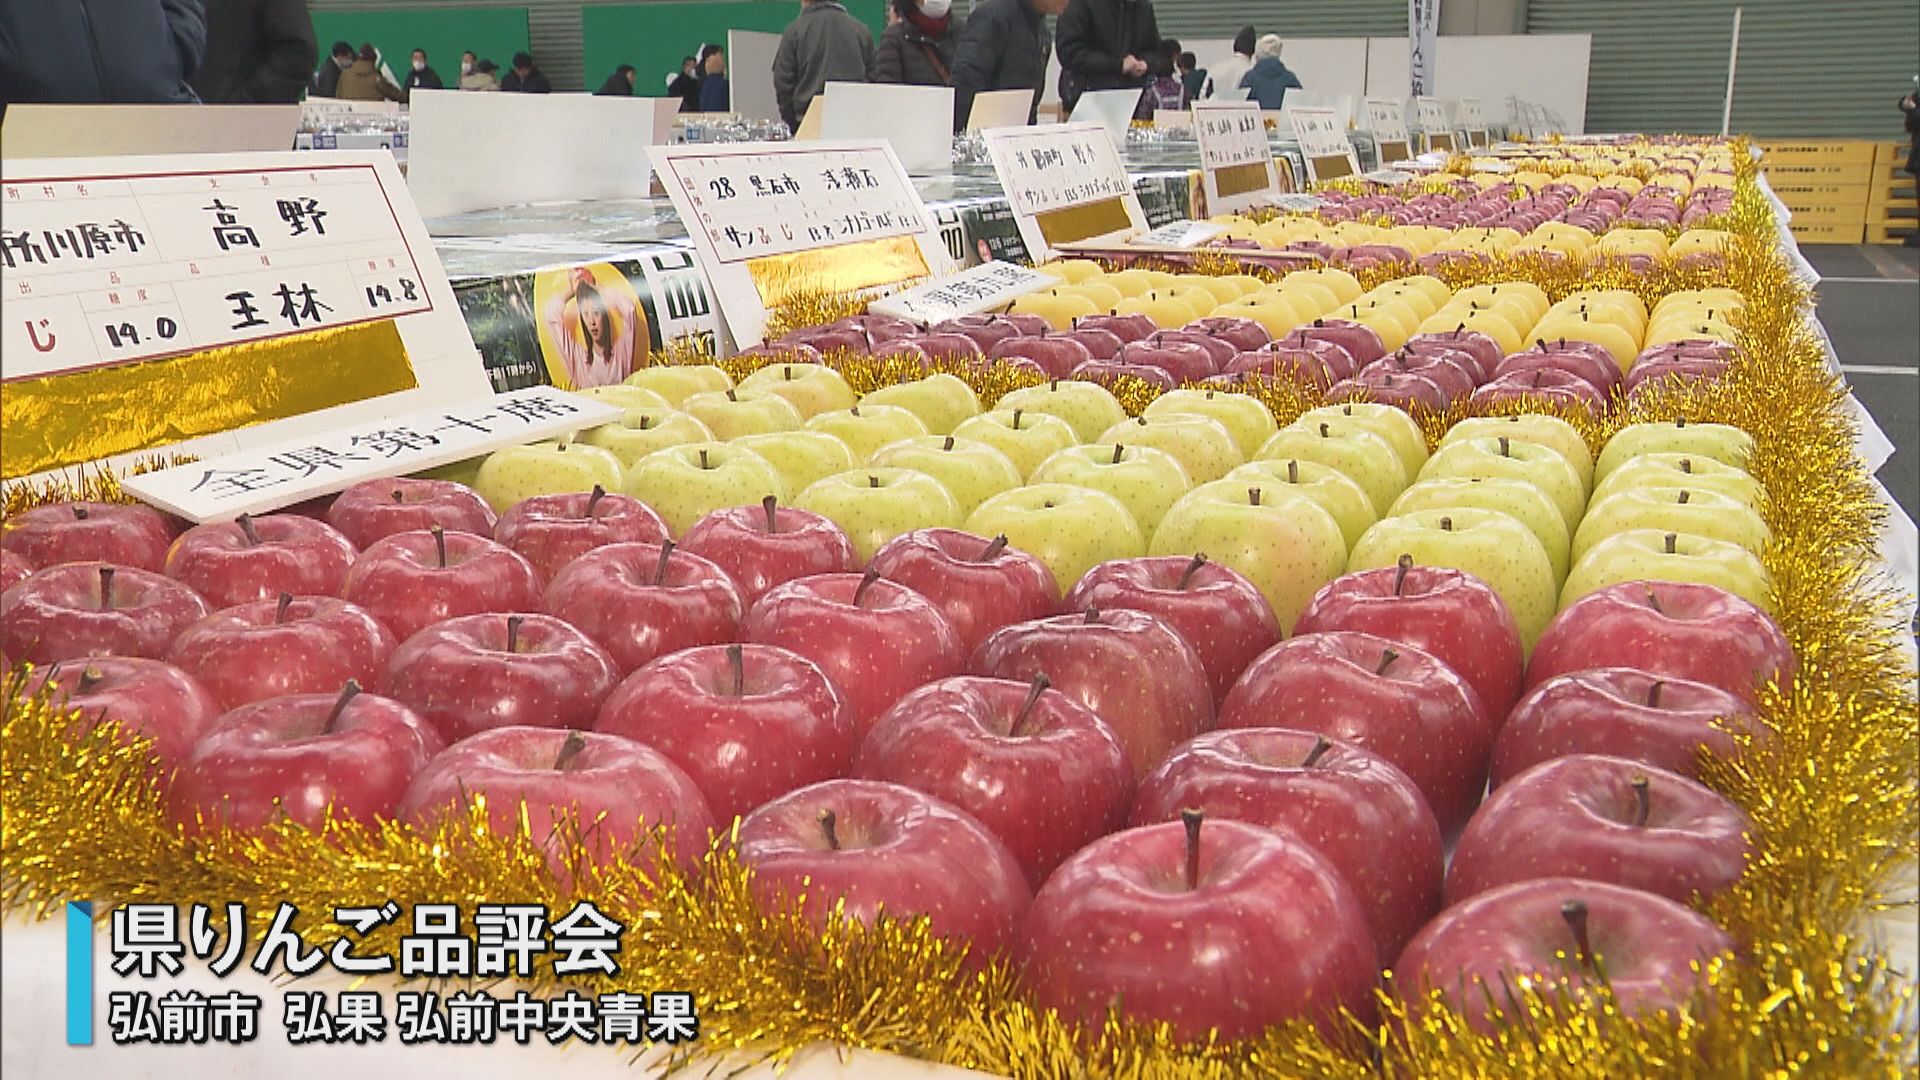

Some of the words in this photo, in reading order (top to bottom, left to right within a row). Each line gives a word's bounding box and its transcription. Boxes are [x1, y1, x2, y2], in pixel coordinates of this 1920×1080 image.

[709, 176, 737, 200] 28
[748, 171, 801, 197] 黒石市
[819, 166, 880, 191] 浅瀬石
[202, 196, 328, 251] 高野
[224, 282, 335, 331] 王林
[25, 318, 56, 352] じ
[189, 396, 579, 500] 全県第十席
